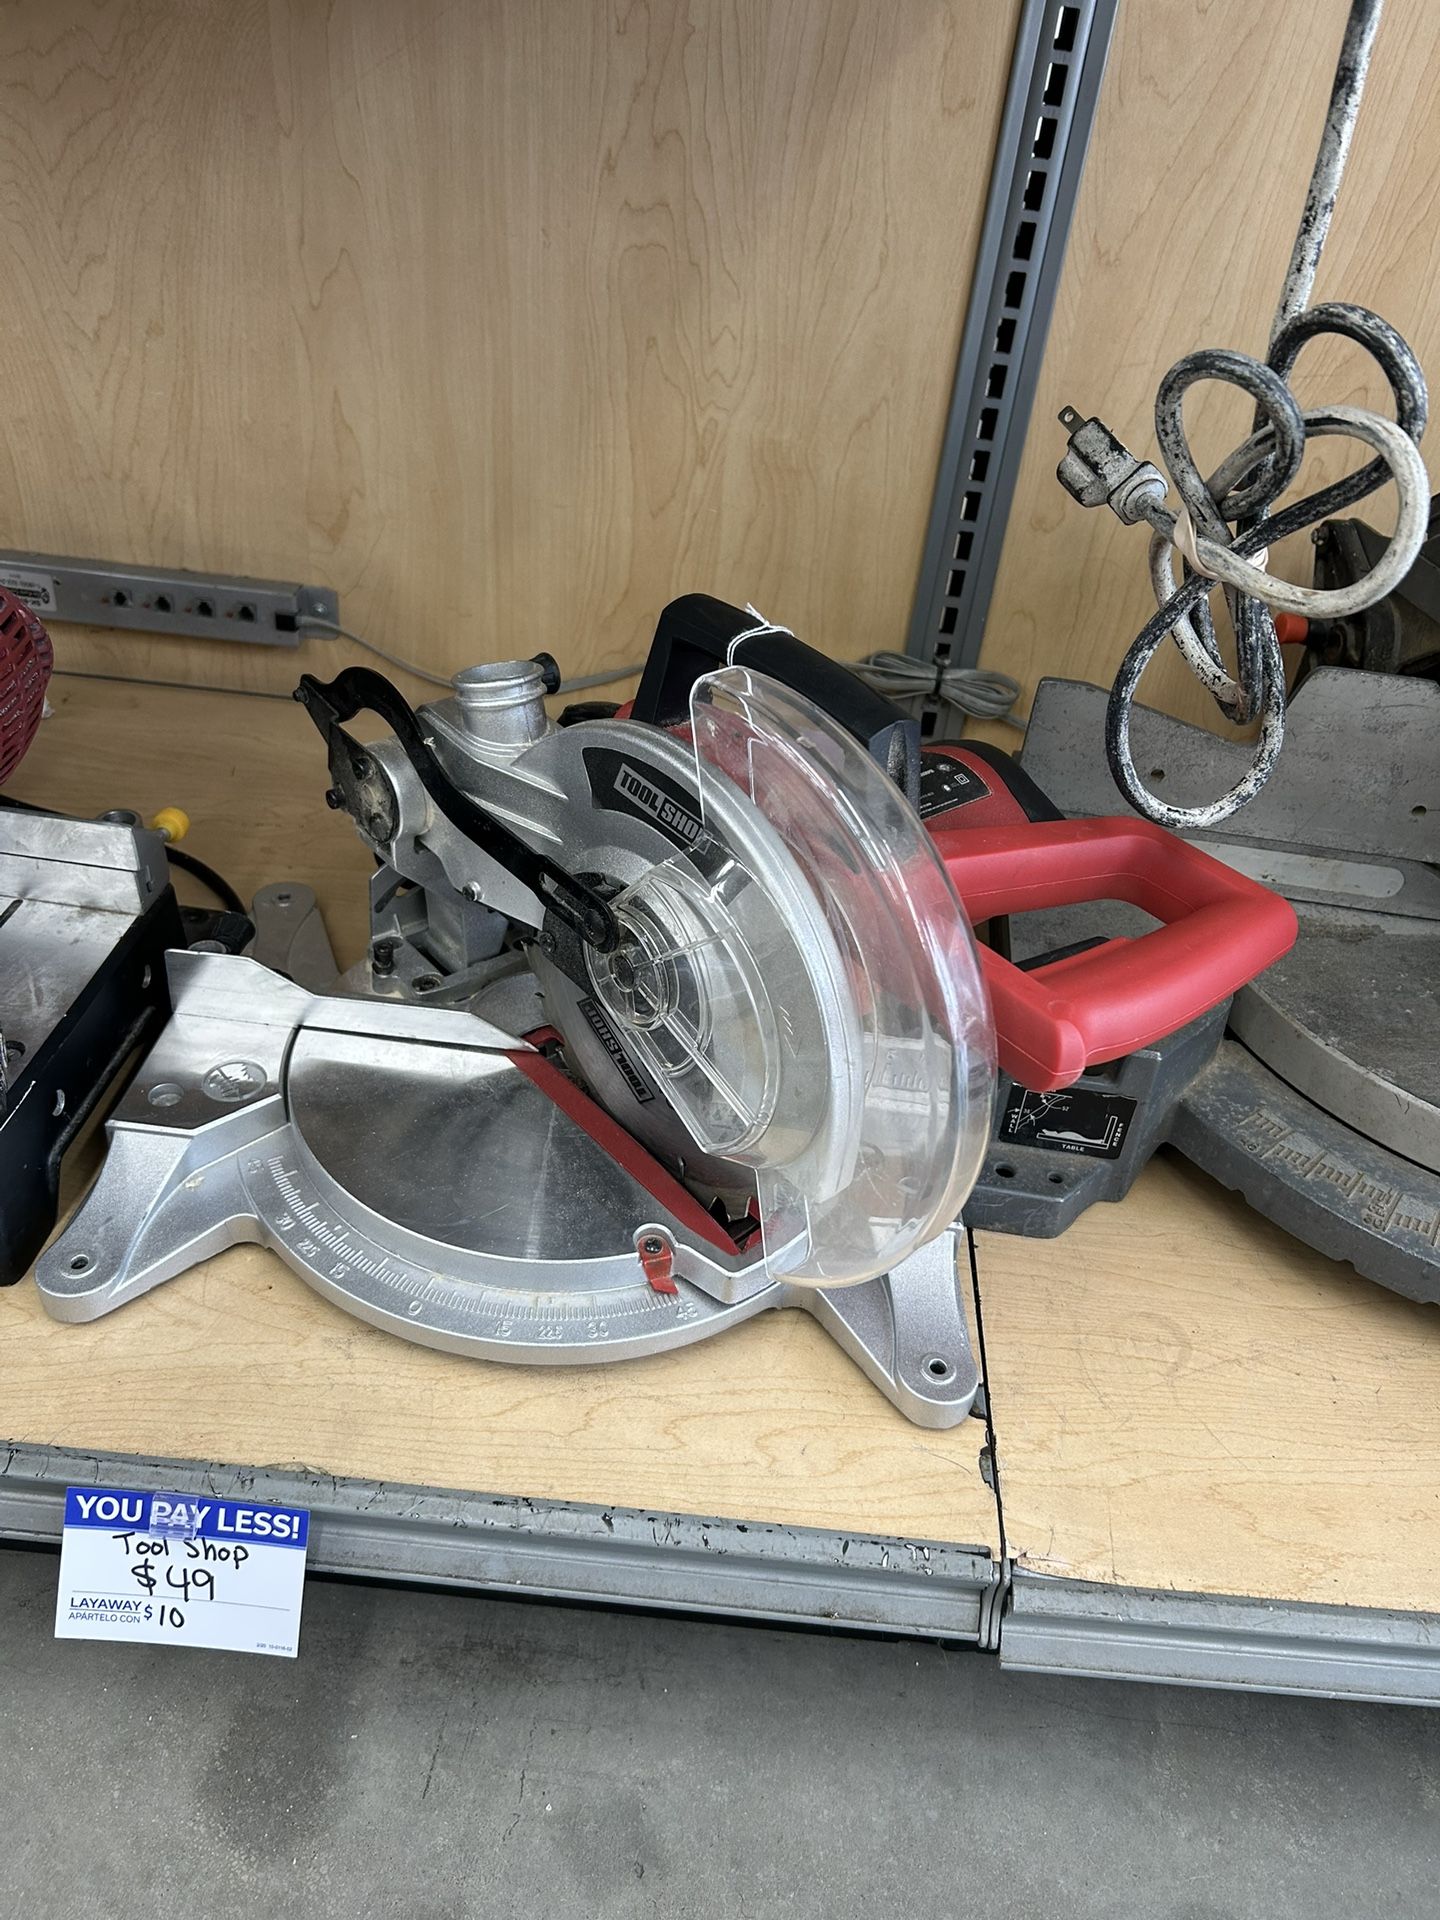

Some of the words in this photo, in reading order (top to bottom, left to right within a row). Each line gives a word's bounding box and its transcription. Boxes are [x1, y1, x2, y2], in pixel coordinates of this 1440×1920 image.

[620, 769, 660, 813] TOOL
[660, 802, 704, 840] SHO
[1008, 1113, 1019, 1133] WALL
[1112, 1122, 1124, 1147] FENCE
[1061, 1143, 1085, 1153] TABLE
[76, 1495, 143, 1523] YOU
[152, 1501, 210, 1529] PAY
[218, 1507, 300, 1539] LESS!
[112, 1531, 169, 1556] Tool
[183, 1536, 249, 1569] Shop
[70, 1597, 142, 1612] LAYAWAY
[68, 1609, 118, 1622] APÁRTELO
[119, 1612, 141, 1624] CON
